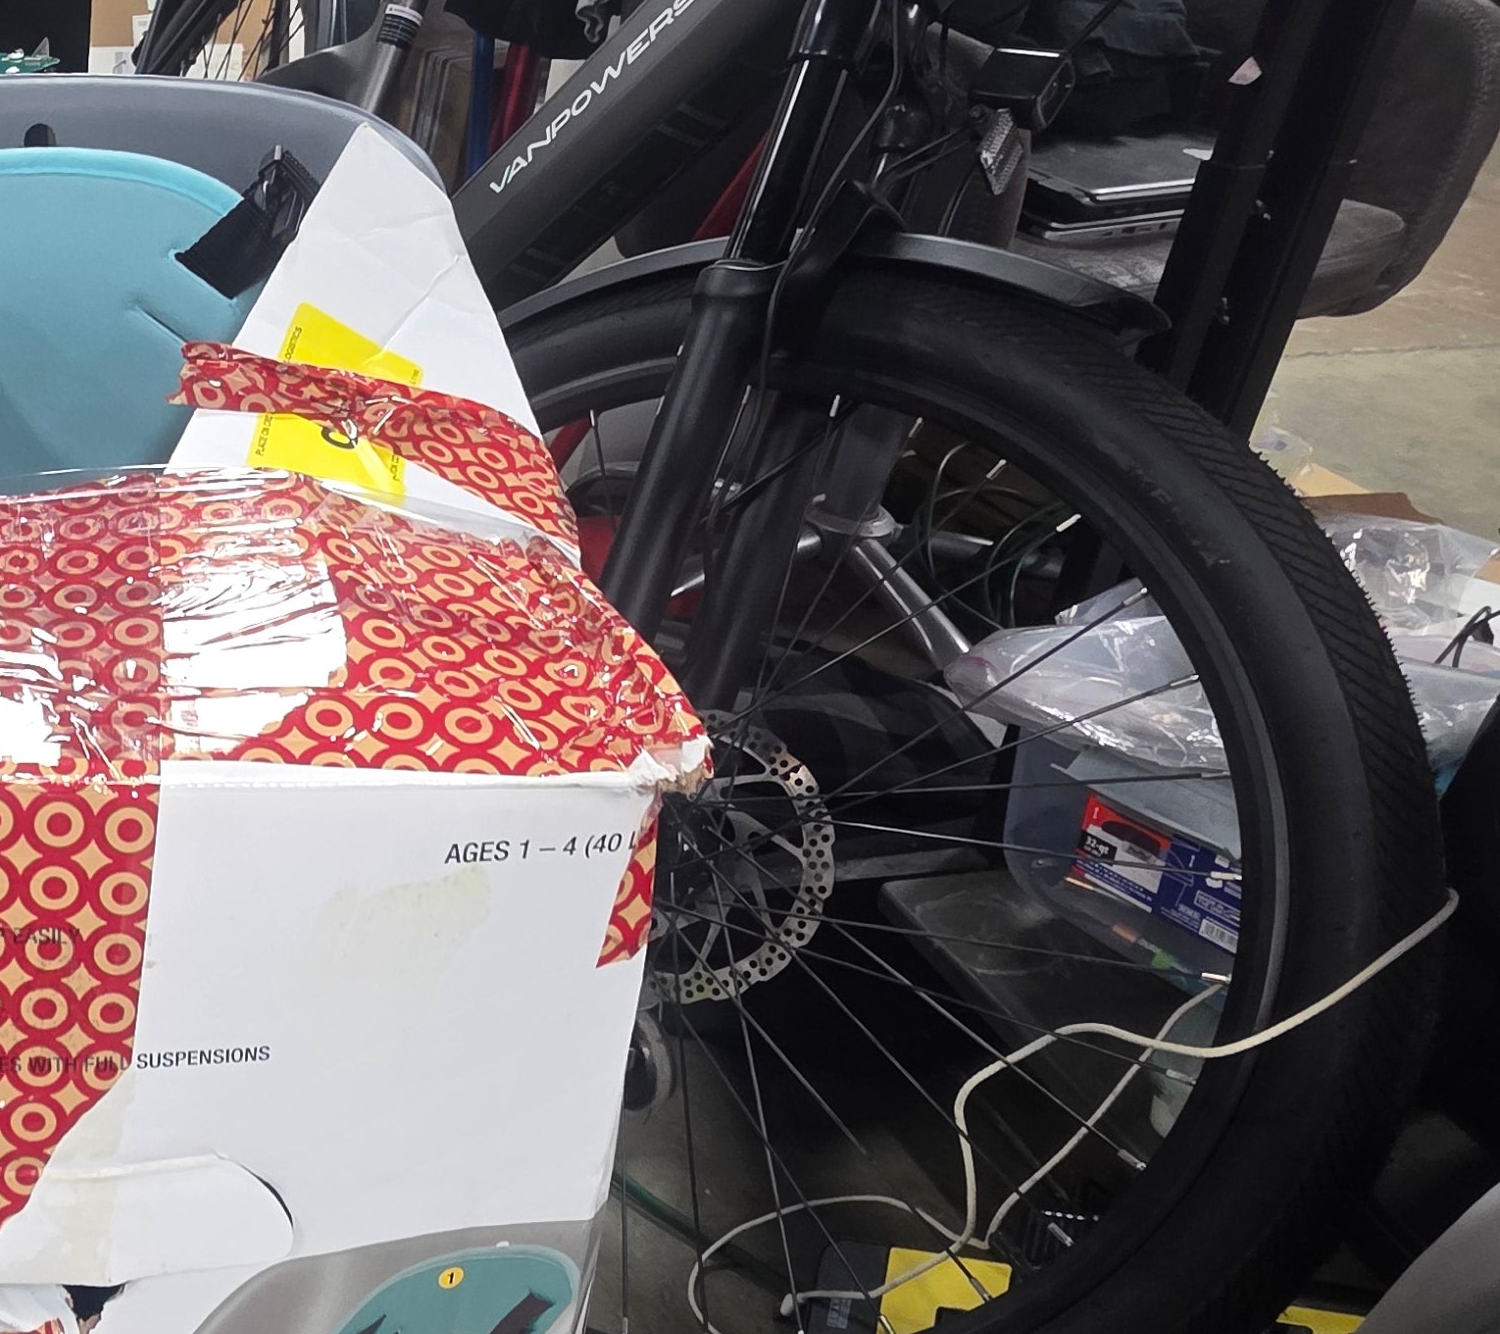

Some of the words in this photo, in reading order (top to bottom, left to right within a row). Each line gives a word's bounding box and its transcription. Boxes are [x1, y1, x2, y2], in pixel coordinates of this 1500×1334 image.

[444, 840, 510, 864] AGES
[519, 839, 530, 860] 1
[562, 836, 577, 856] 4
[585, 832, 622, 859] (40
[12, 927, 81, 946] EASILY
[28, 1055, 76, 1073] WITH
[83, 1053, 129, 1072] FULL
[136, 1045, 271, 1070] SUSPENSIONS
[447, 1271, 455, 1285] 1
